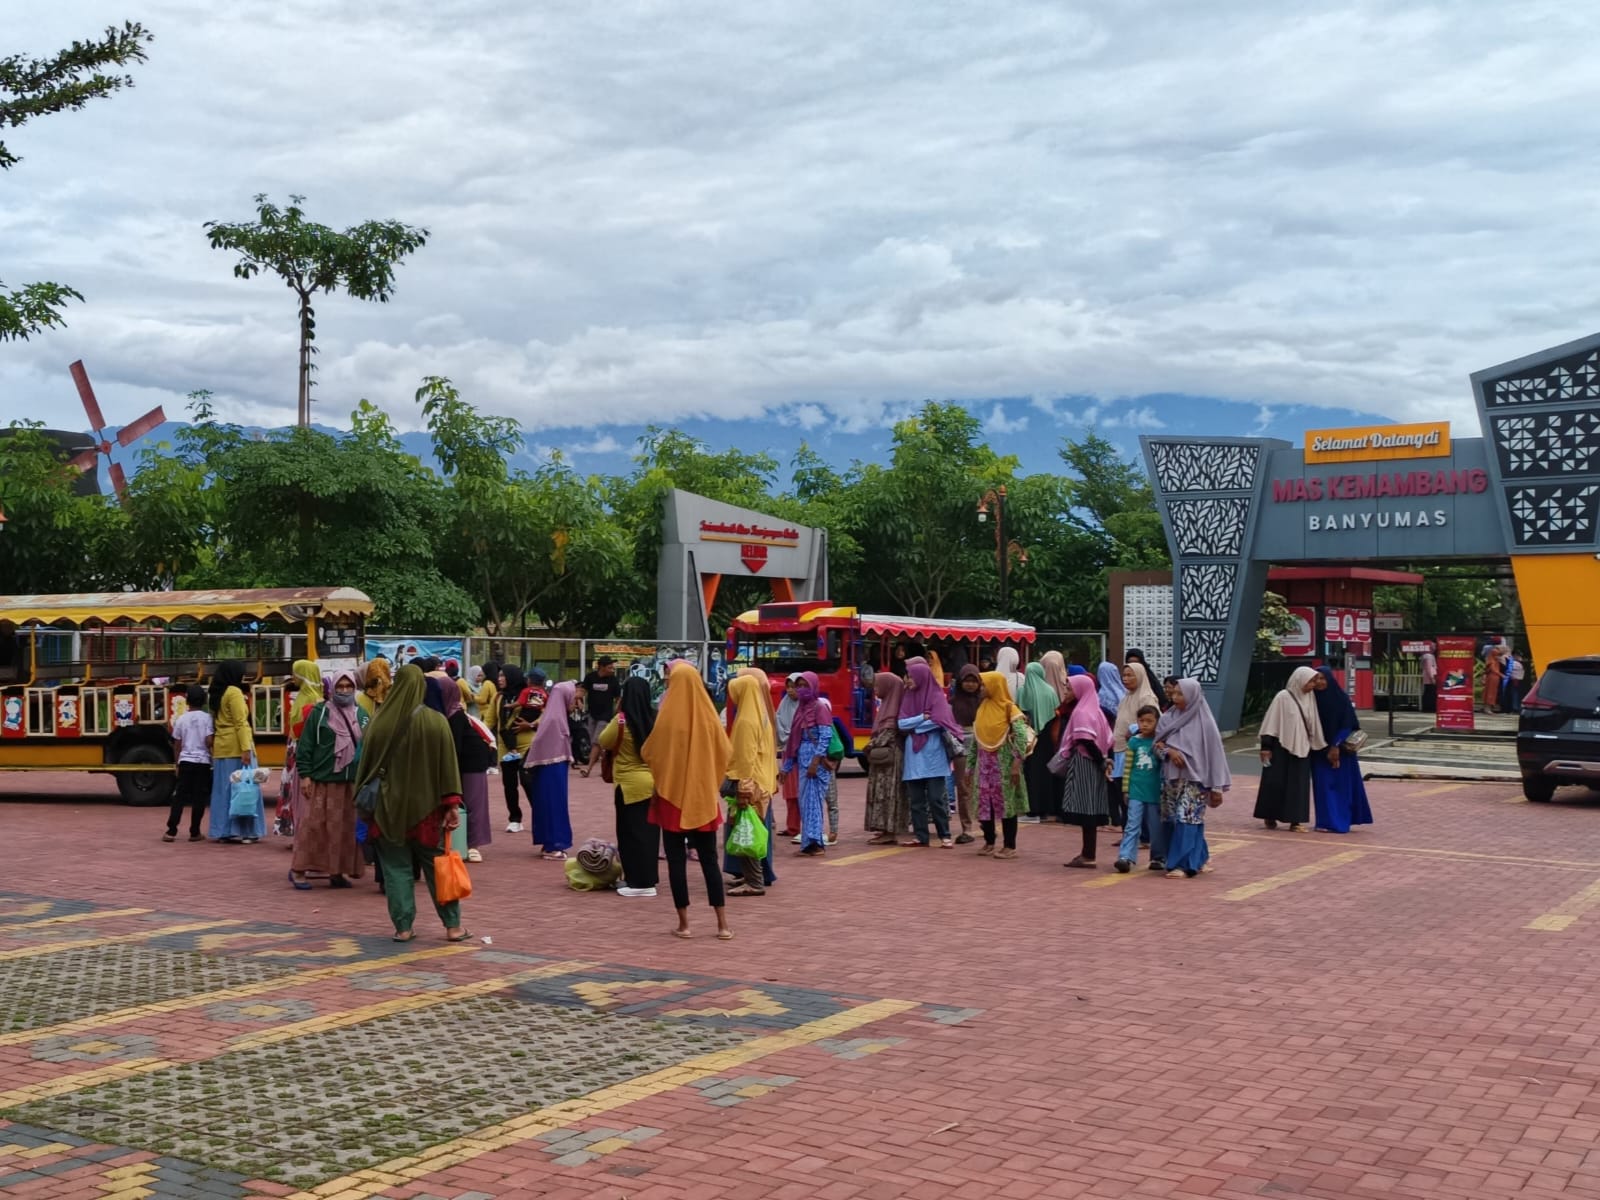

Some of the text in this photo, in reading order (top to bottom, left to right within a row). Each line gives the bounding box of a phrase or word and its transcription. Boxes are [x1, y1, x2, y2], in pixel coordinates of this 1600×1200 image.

[1311, 429, 1440, 452] Selamat Datang di
[1272, 468, 1489, 503] MAS KEMAMBANG
[1308, 509, 1448, 532] BANYUMAS
